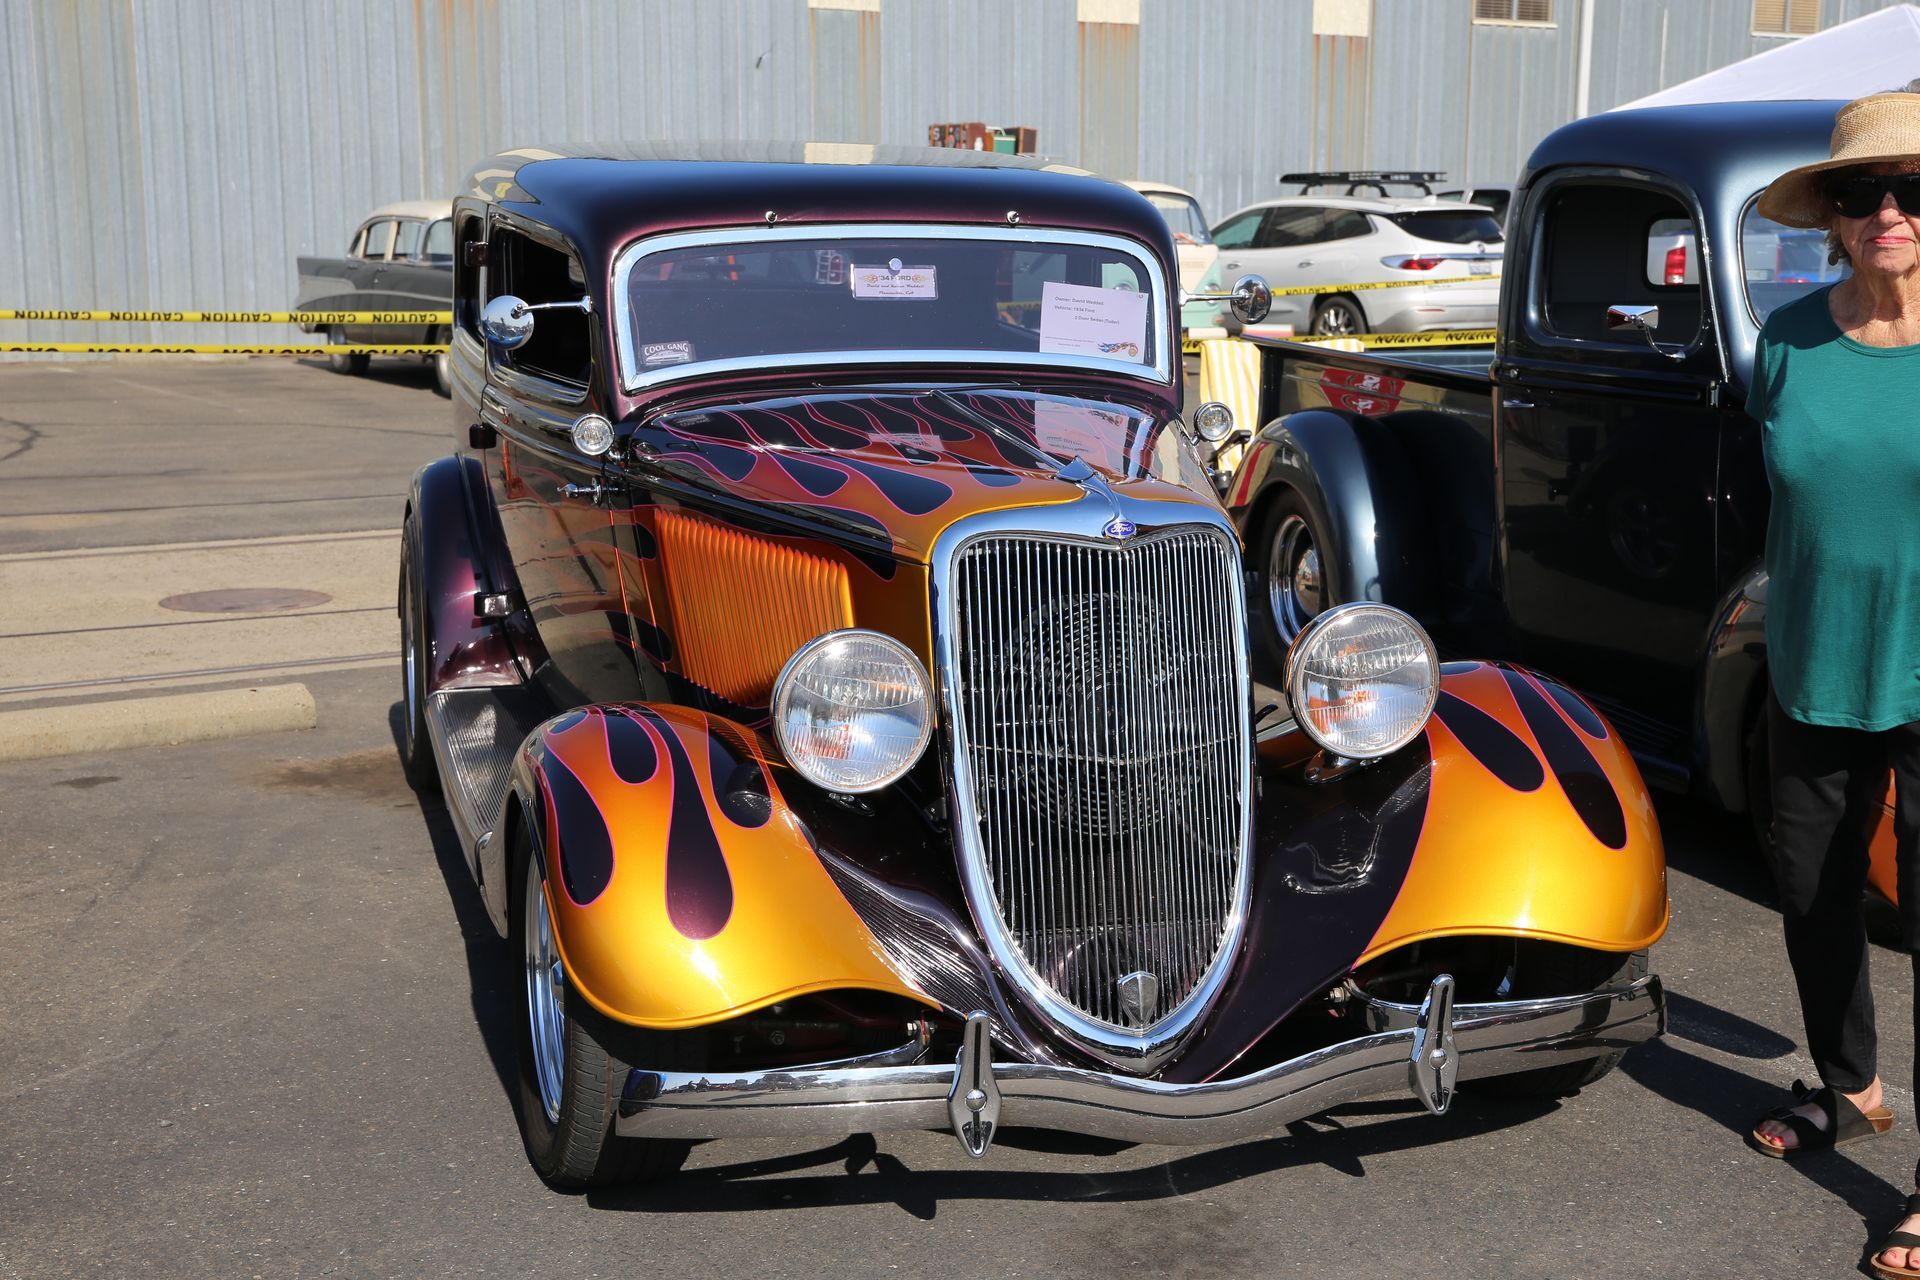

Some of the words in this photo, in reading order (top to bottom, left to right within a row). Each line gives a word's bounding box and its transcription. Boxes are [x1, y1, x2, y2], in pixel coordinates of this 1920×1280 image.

[14, 310, 91, 320] CAUTION
[110, 312, 184, 322] CAUTION
[201, 312, 272, 322] CAUTION
[289, 313, 356, 322] CAUTION
[372, 314, 438, 322] CAUTION
[1374, 334, 1432, 344] CAUTION
[644, 344, 665, 356] COOL
[668, 342, 688, 352] GANG
[1110, 522, 1132, 533] Ford
